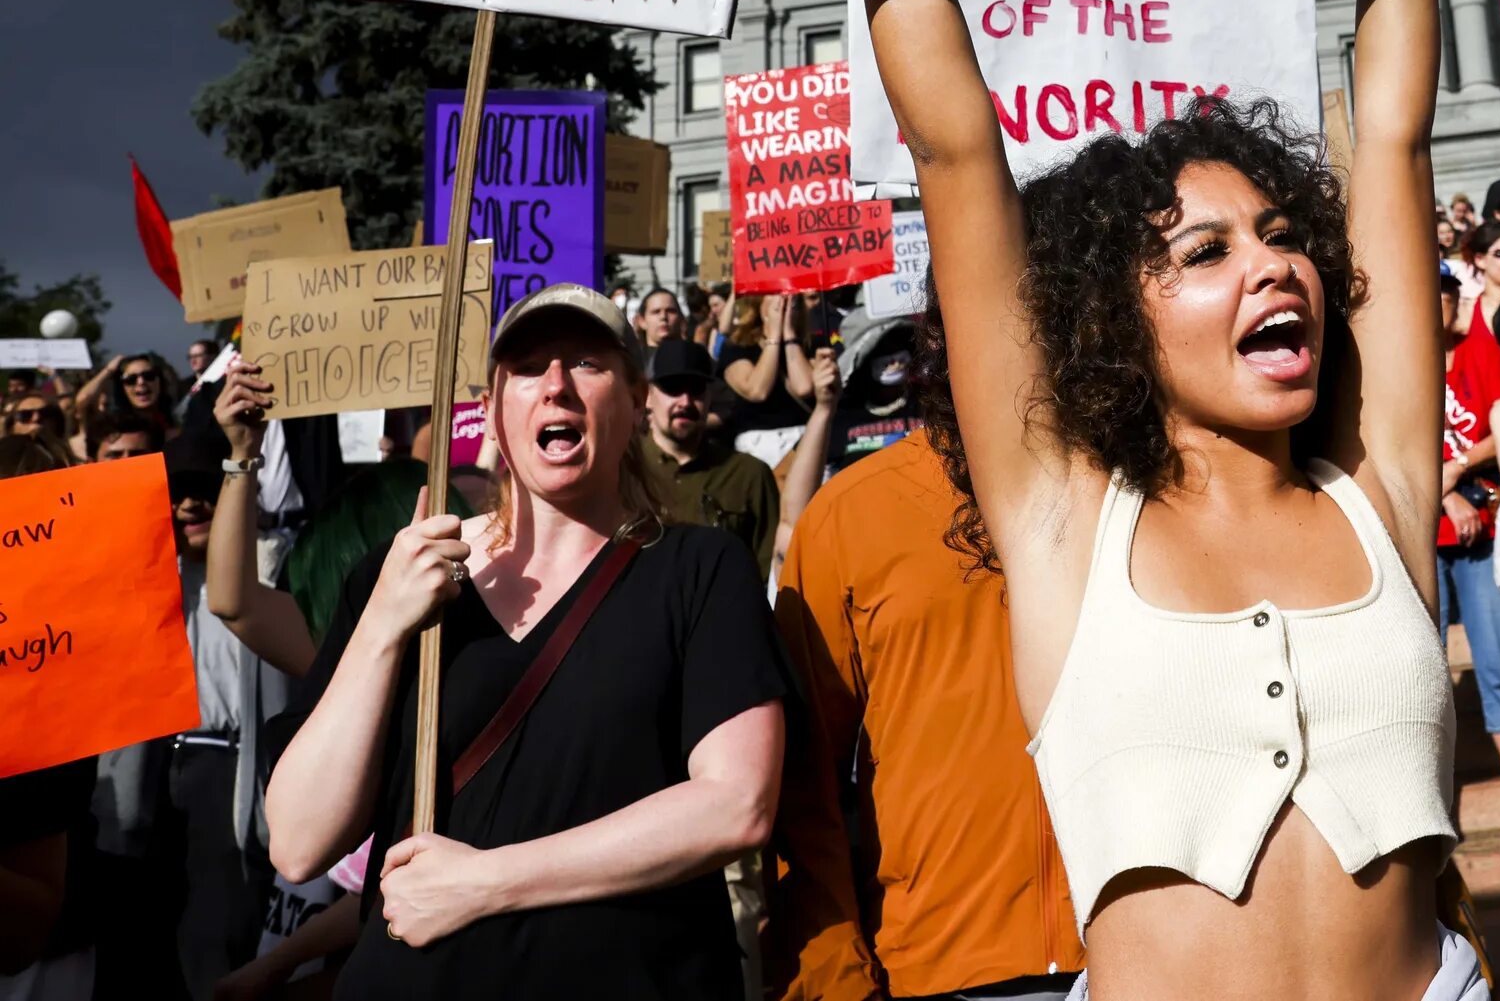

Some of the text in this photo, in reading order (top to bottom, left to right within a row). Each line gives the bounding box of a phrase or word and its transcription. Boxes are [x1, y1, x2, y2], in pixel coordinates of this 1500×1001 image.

[735, 79, 798, 107] YOU
[990, 78, 1230, 145] NORITY
[738, 106, 800, 137] LIKE
[443, 110, 589, 187] AORTION
[741, 126, 851, 162] WEARIN
[747, 164, 765, 187] A
[744, 177, 854, 219] IMAGIN
[746, 204, 882, 243] BEING FORCED TO
[748, 243, 819, 272] HAVE
[823, 226, 892, 259] BABY
[261, 268, 276, 305] I
[298, 263, 366, 299] WANT
[376, 254, 416, 286] OUR
[268, 311, 337, 340] GROW
[361, 305, 389, 333] UP
[0, 623, 73, 673] ugh
